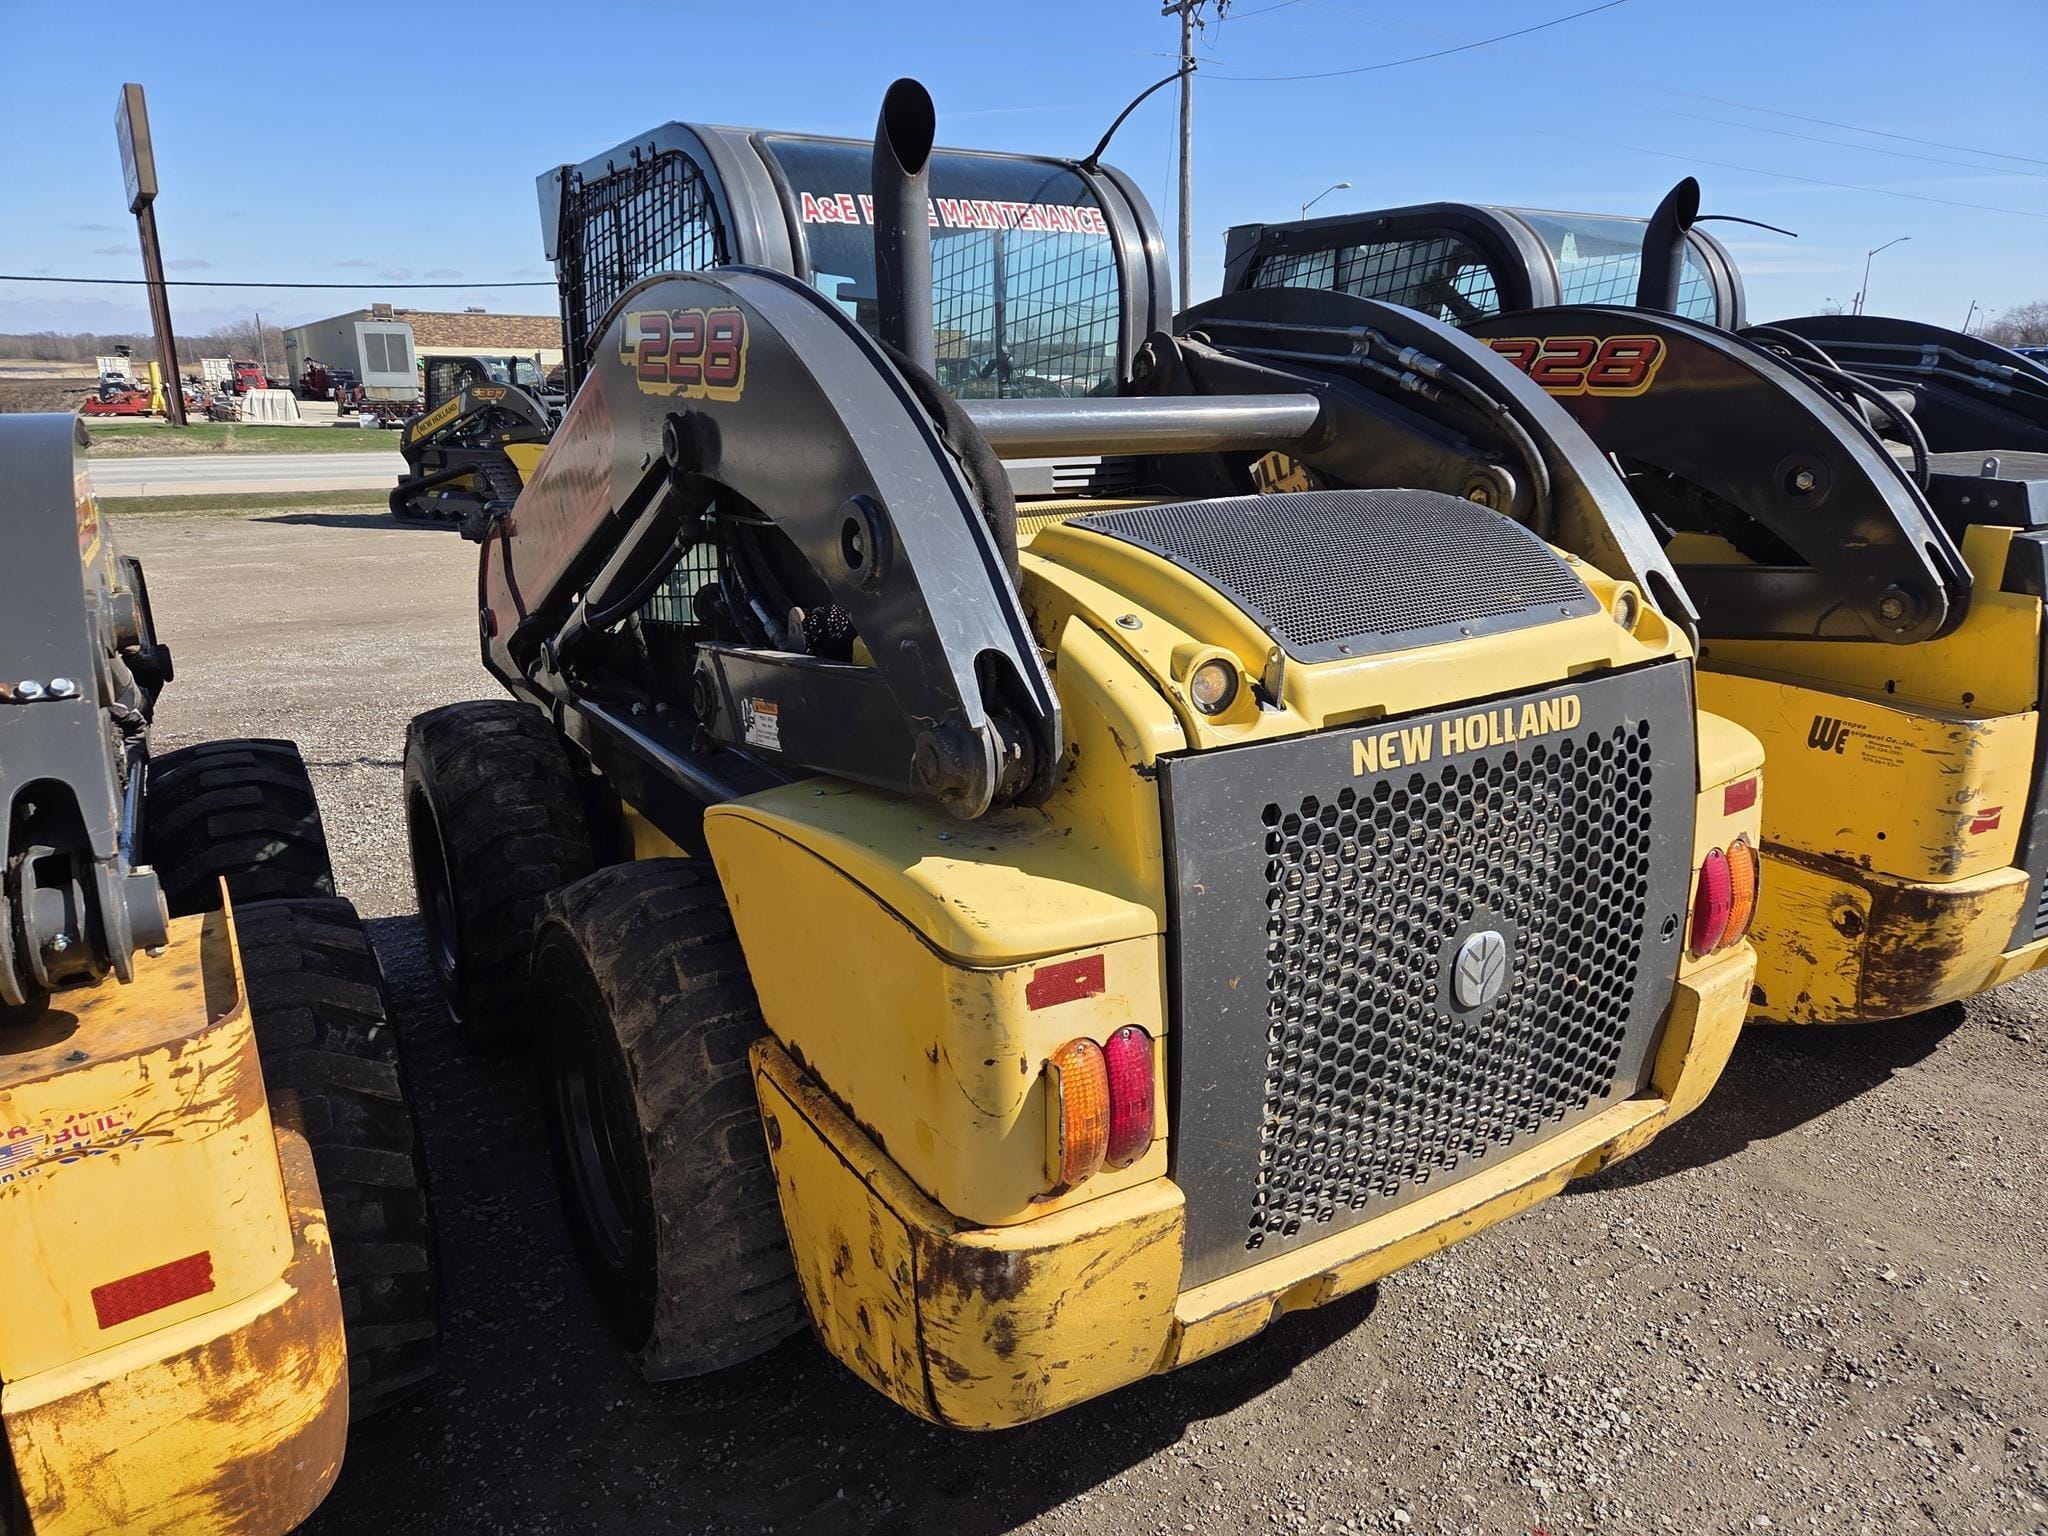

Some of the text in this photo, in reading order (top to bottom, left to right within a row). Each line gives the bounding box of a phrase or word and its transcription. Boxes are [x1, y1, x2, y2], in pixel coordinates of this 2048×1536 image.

[800, 192, 1108, 235] A&E HE MAINTENANCE
[432, 403, 458, 425] HOLLAND
[1352, 694, 1582, 776] NEW HOLLAND
[54, 1111, 132, 1145] BUIL
